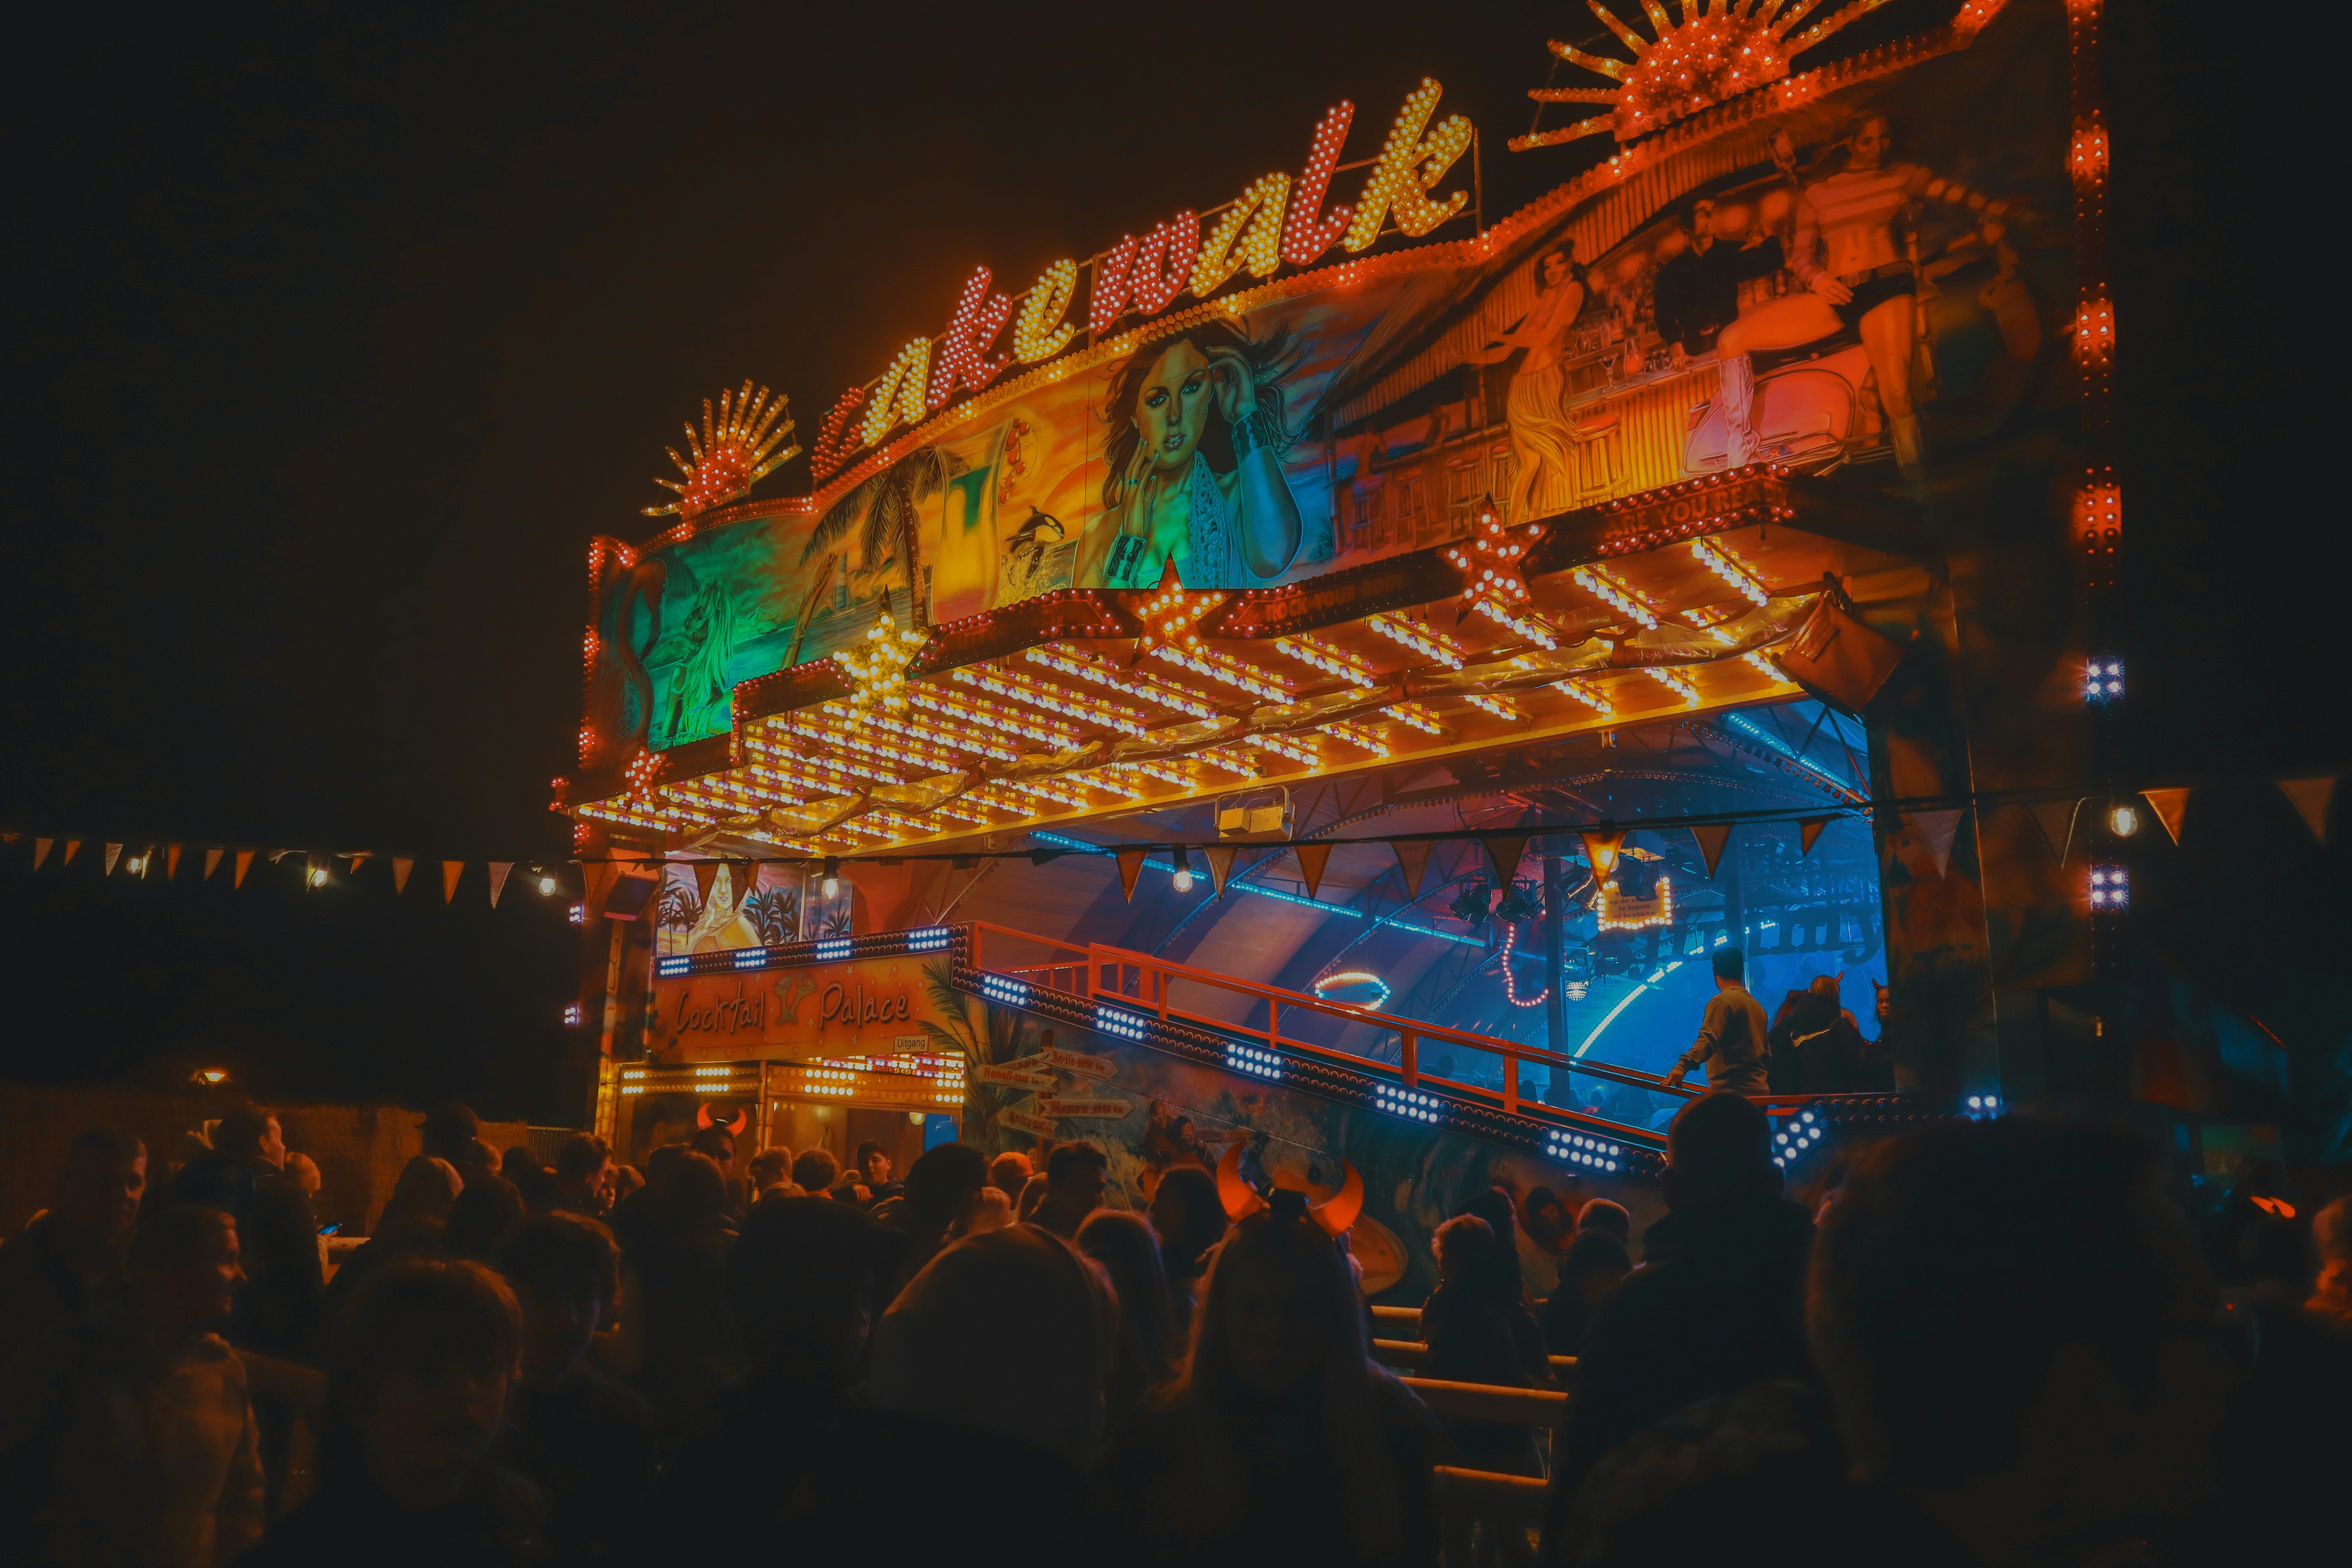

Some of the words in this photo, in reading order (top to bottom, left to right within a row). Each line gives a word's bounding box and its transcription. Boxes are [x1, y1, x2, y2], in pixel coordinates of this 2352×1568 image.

[810, 76, 1473, 479] Cakewalk
[1605, 511, 1649, 539] ARE
[1657, 495, 1708, 526] YOU
[1714, 482, 1790, 513] READY
[1265, 596, 1308, 622] ROCK
[1314, 584, 1356, 610] YOUR
[1363, 572, 1405, 596] BODY
[675, 981, 765, 1034] Cocktail
[819, 982, 910, 1028] Palace
[897, 1038, 925, 1050] Uitgang
